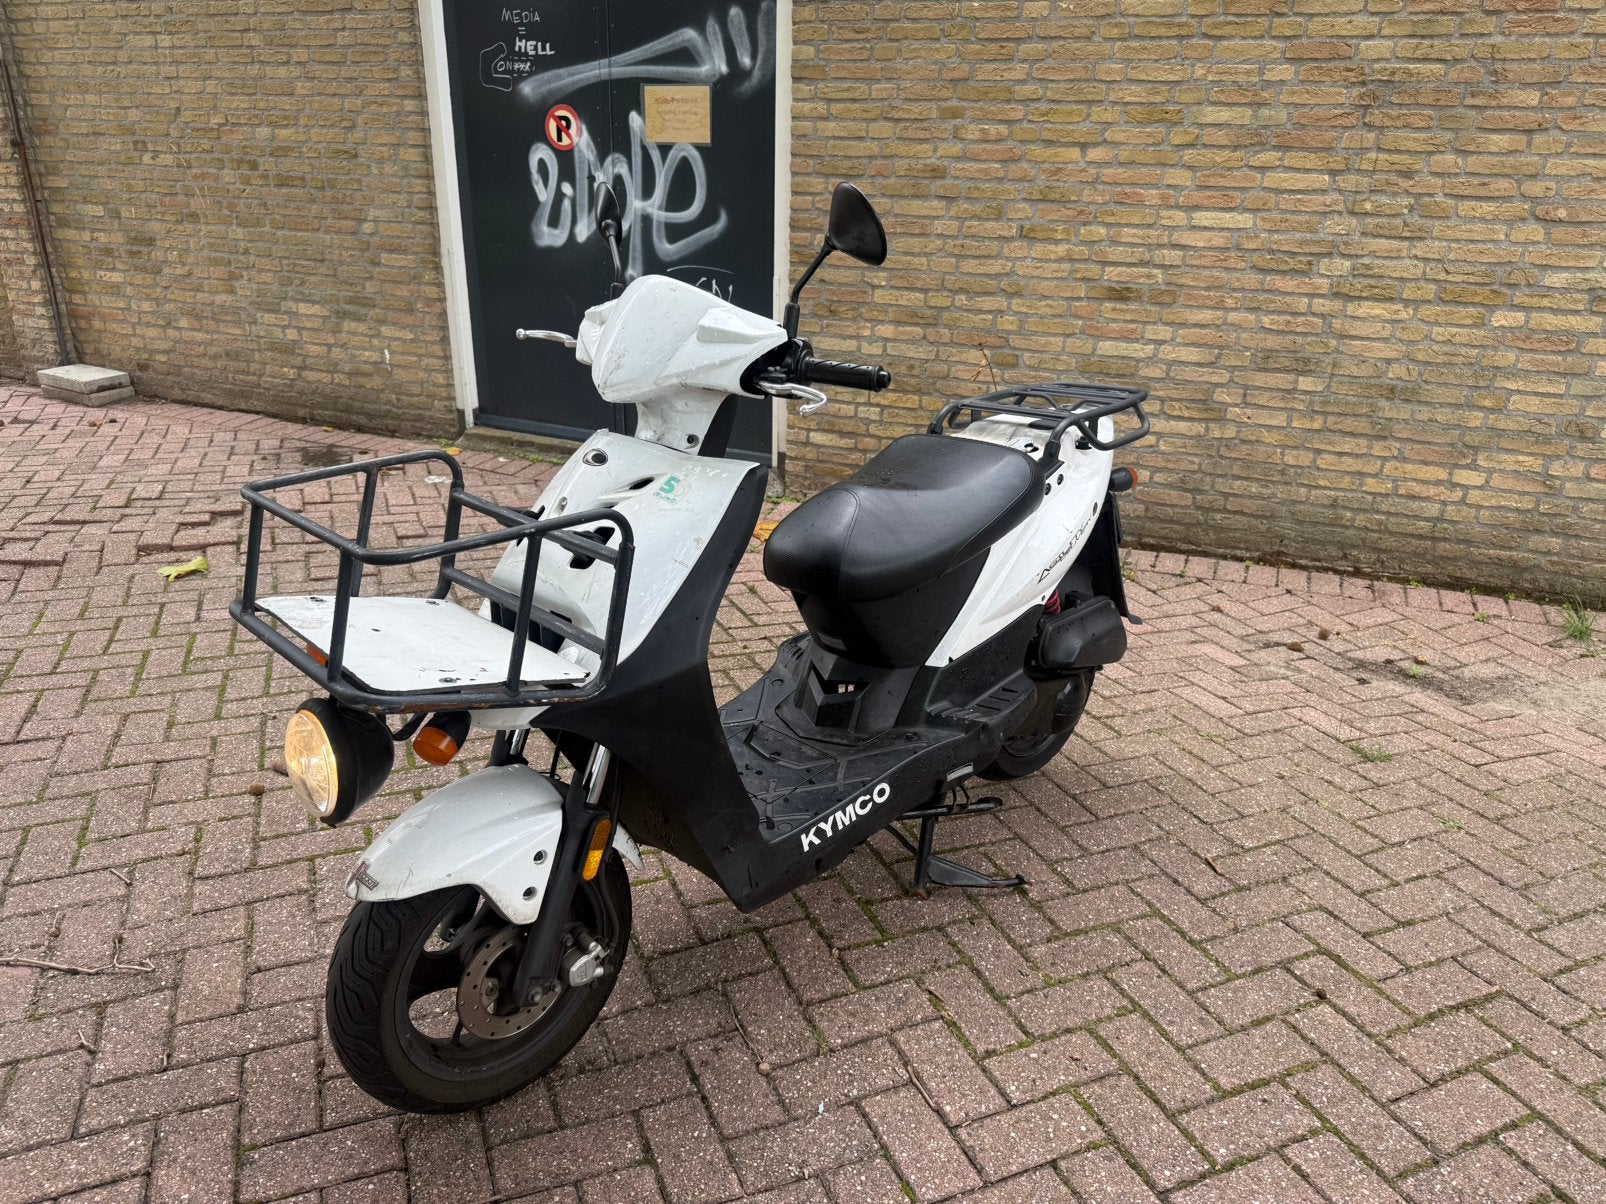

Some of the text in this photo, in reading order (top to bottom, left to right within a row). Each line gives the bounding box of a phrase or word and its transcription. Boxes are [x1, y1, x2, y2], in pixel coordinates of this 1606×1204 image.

[515, 36, 555, 55] HELL
[659, 475, 682, 494] 5
[800, 783, 890, 852] KYMCO
